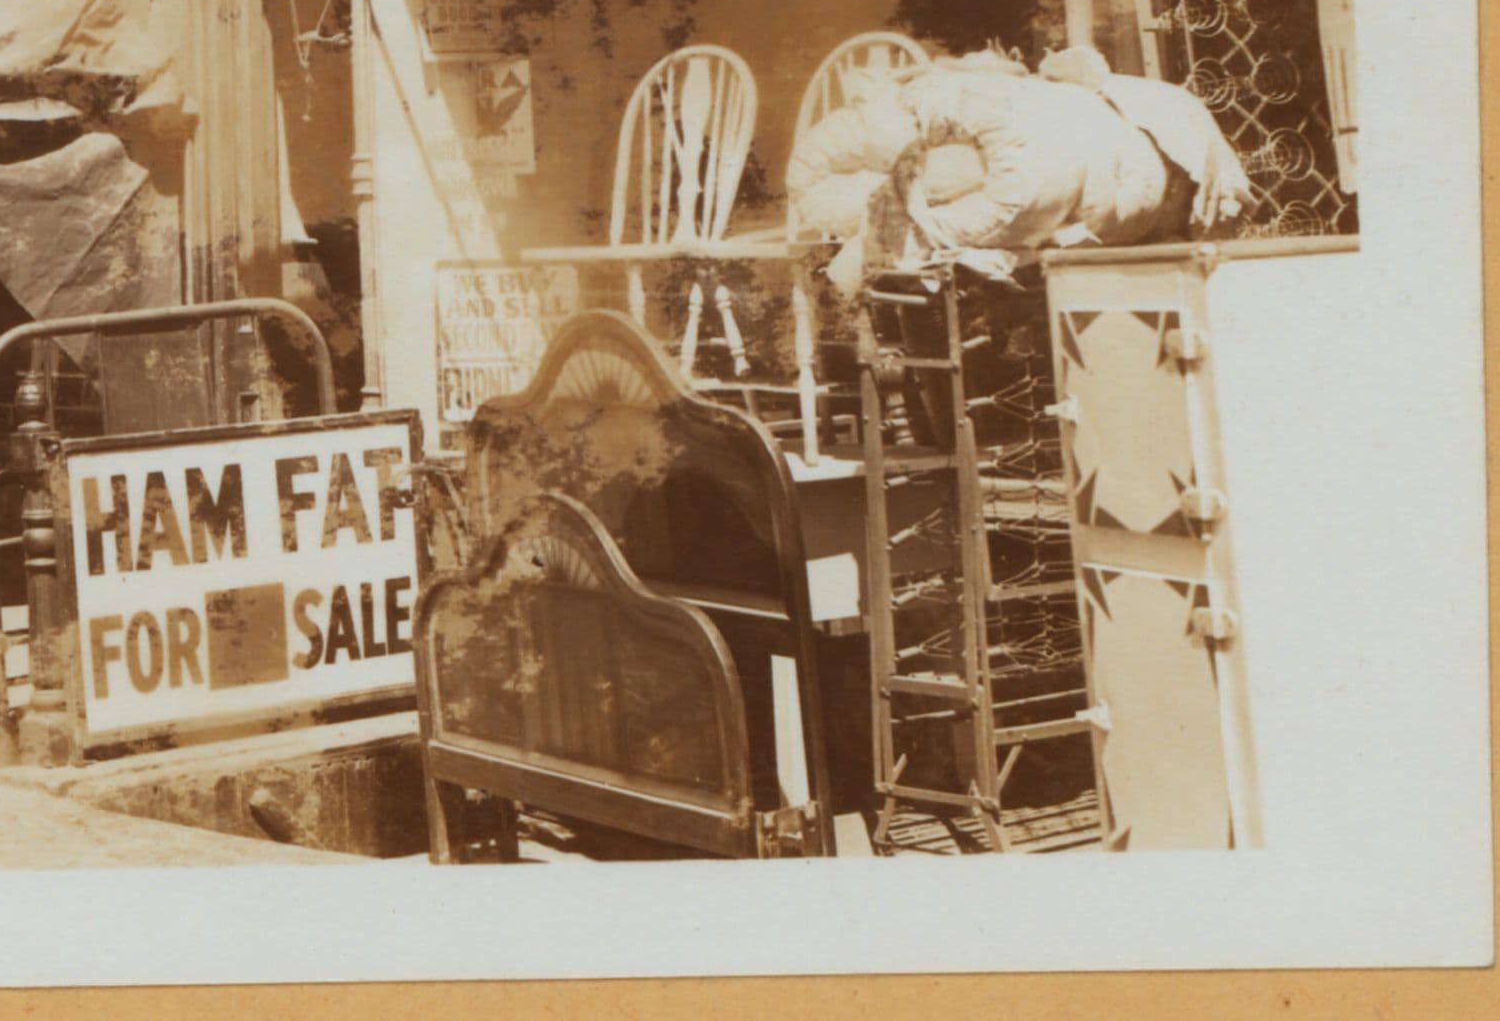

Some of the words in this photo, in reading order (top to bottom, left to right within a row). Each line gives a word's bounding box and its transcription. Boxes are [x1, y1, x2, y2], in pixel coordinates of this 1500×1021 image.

[81, 463, 249, 577] HAM
[274, 446, 403, 554] FAT
[88, 606, 204, 699] FOR
[291, 576, 414, 671] SALE
